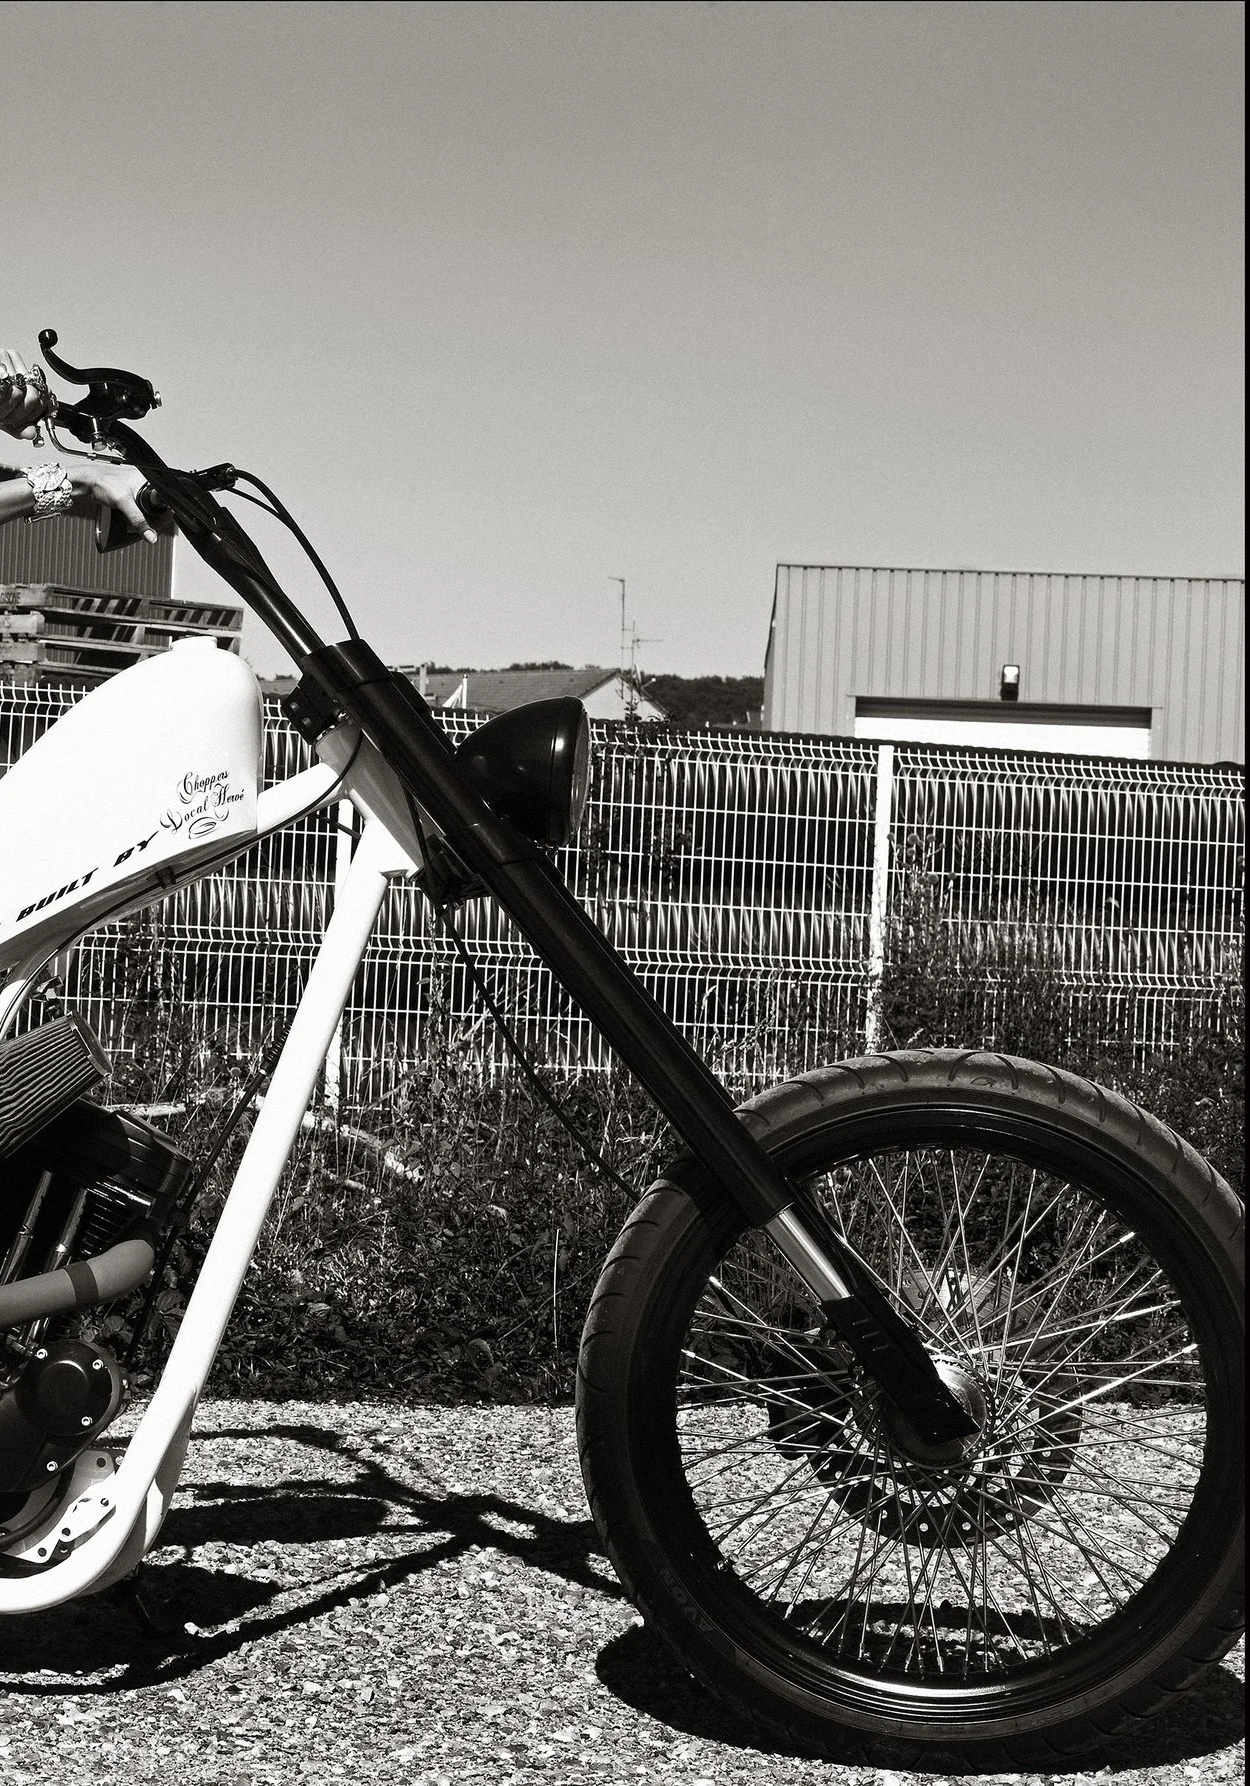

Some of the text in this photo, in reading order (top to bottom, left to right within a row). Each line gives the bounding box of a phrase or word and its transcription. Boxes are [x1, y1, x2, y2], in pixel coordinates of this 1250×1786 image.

[177, 771, 228, 804] Choppers
[15, 867, 99, 922] BUILT
[113, 830, 159, 867] BY
